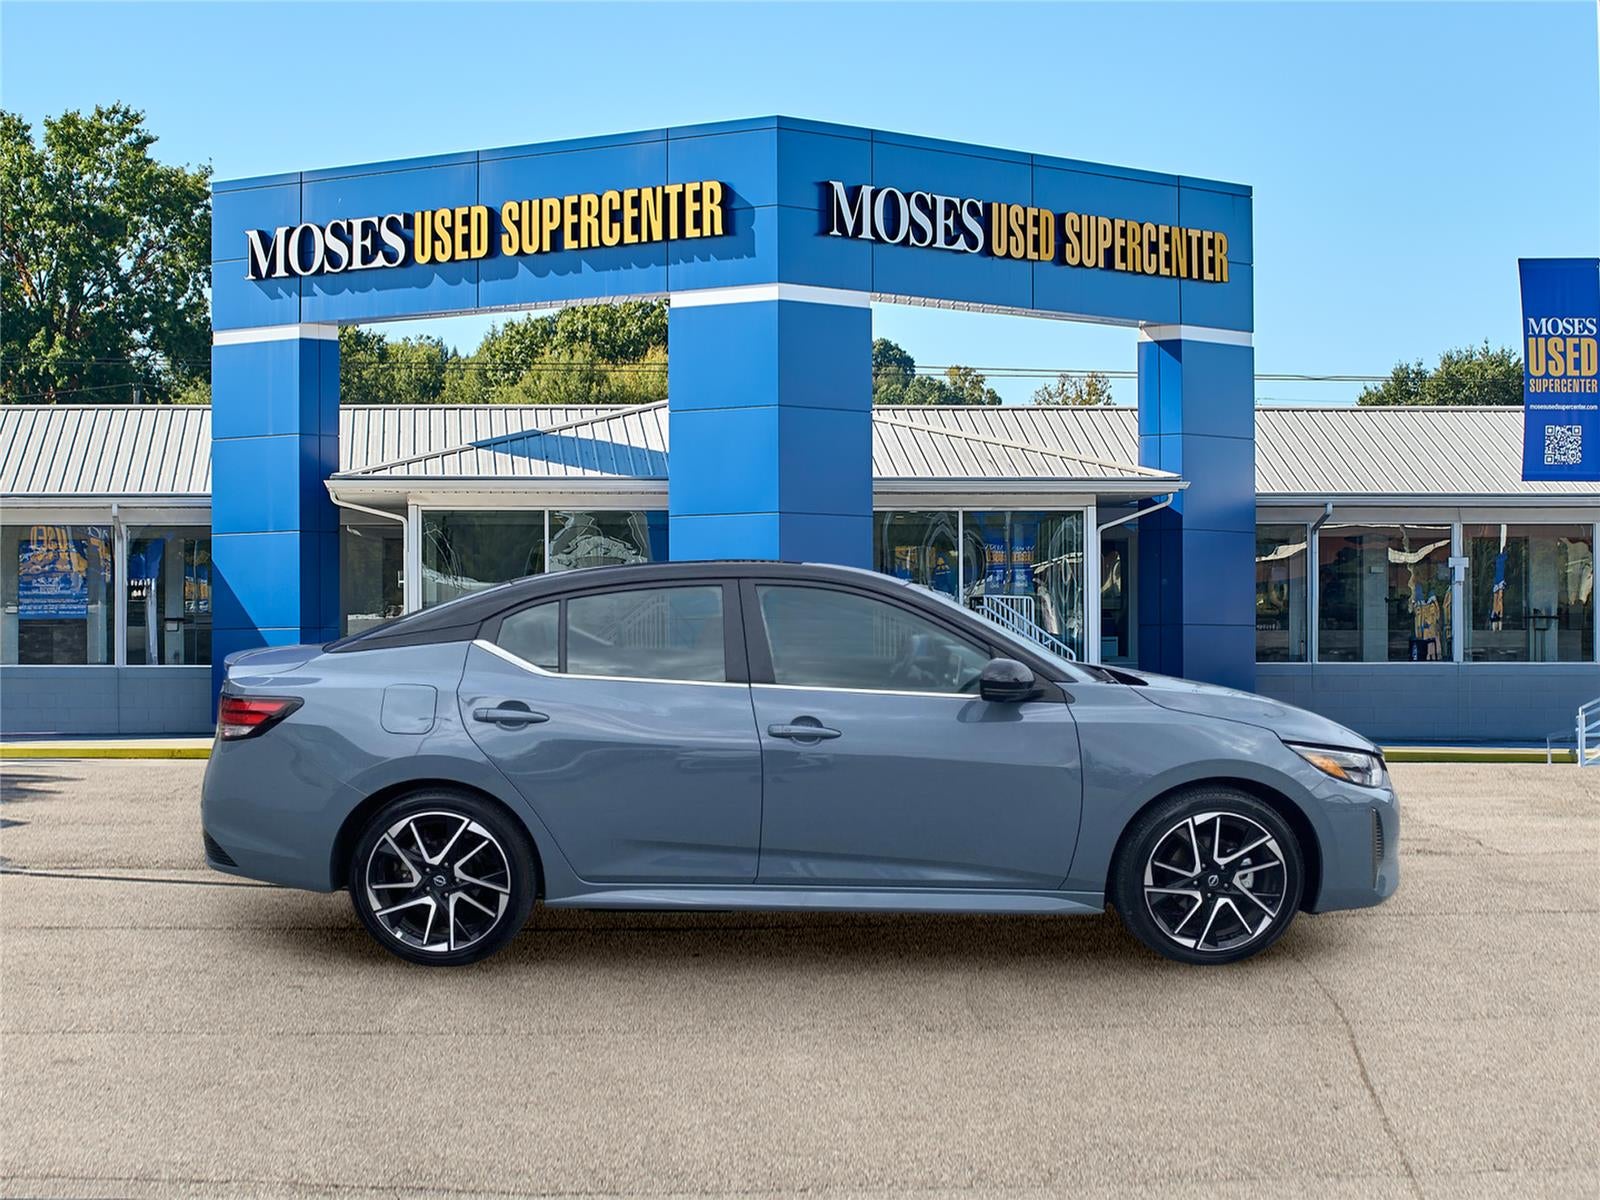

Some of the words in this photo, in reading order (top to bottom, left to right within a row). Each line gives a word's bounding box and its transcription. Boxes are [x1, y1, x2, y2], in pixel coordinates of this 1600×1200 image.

[243, 213, 406, 280] MOSES
[414, 205, 488, 263] USED
[501, 181, 723, 256] SUPERCENTER
[829, 180, 985, 254] MOSES
[991, 202, 1055, 261] USED
[1065, 211, 1229, 282] SUPERCENTER
[1528, 317, 1597, 336] MOSES
[1528, 337, 1598, 376] USED
[1529, 378, 1598, 393] SUPERCENTER
